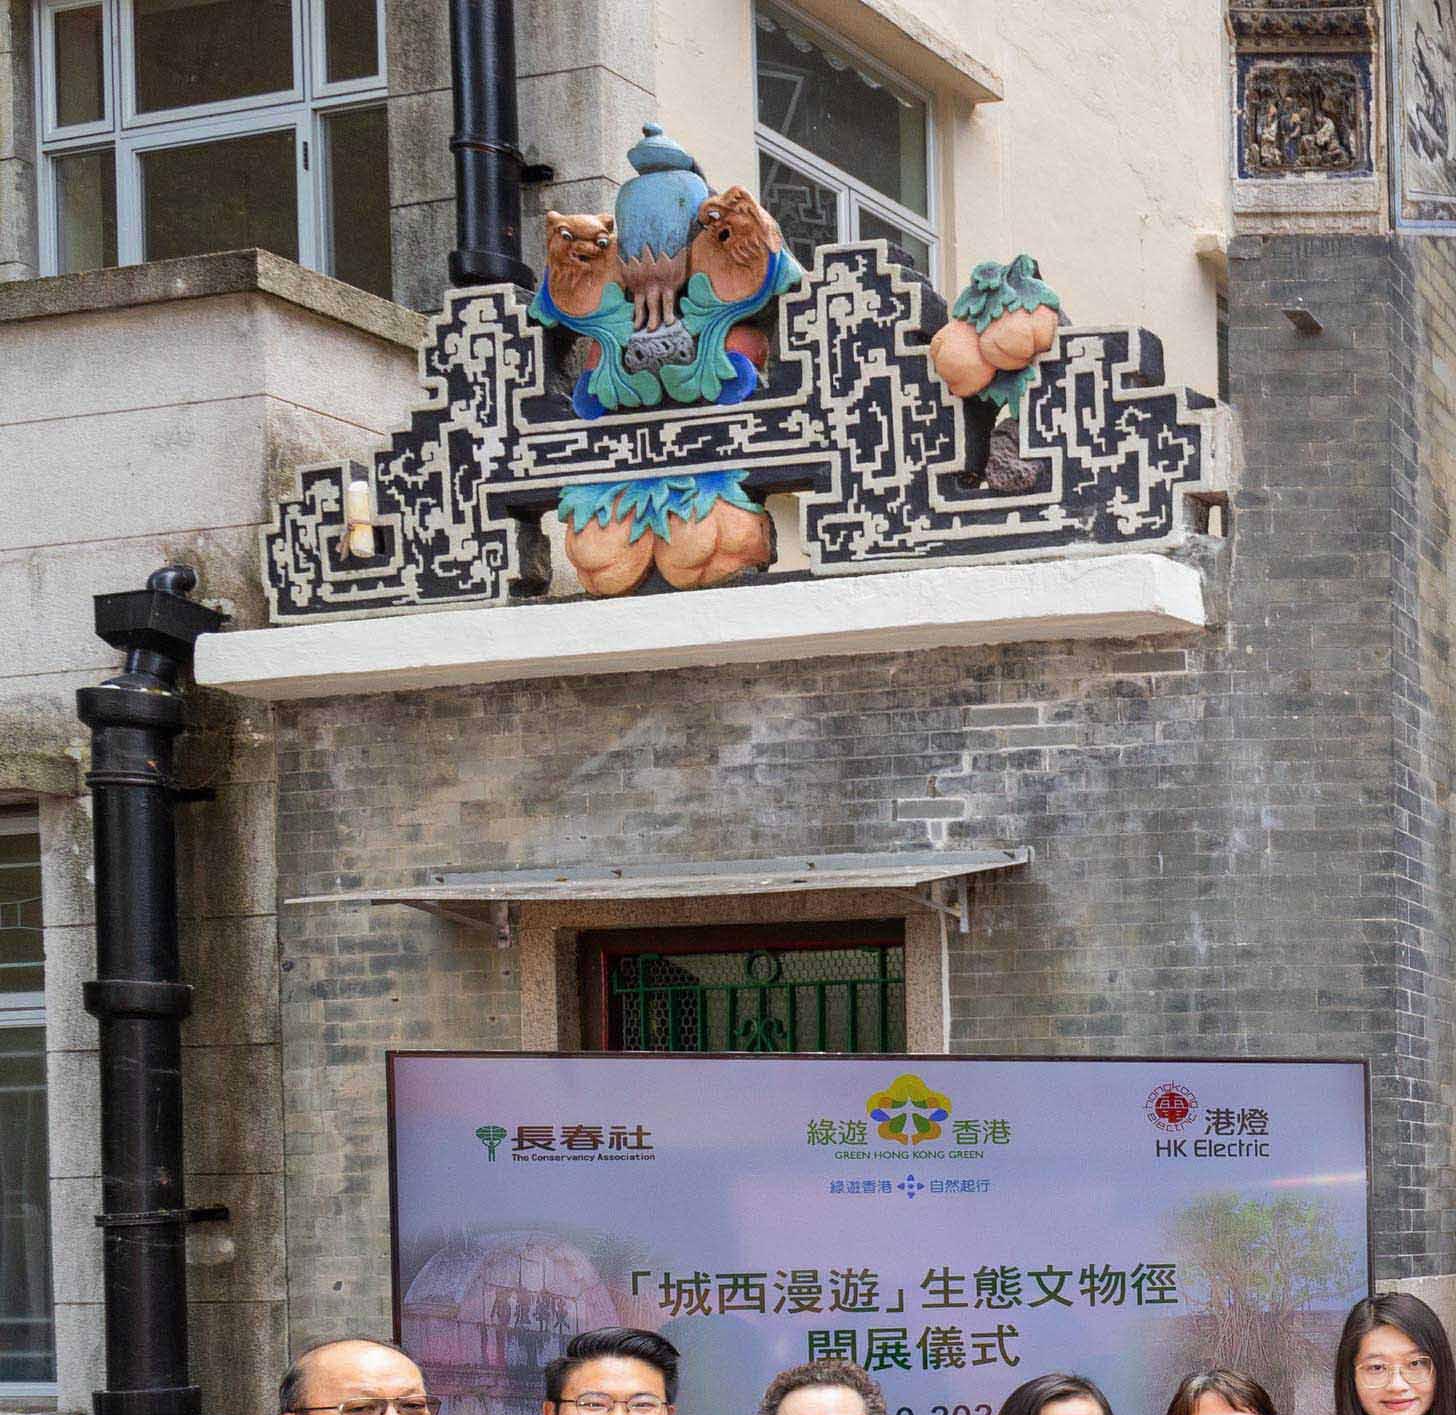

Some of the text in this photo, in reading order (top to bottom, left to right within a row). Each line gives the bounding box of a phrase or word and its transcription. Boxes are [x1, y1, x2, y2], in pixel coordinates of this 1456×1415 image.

[807, 1119, 1012, 1146] 綠遊 香港
[1204, 1108, 1269, 1136] 港燈
[511, 1124, 654, 1152] 長春社
[1155, 1139, 1270, 1158] HK Electric
[531, 1153, 595, 1163] Conservancy
[597, 1152, 656, 1162] Association
[834, 1150, 985, 1160] GREEN HONG KONG GREEN
[808, 1324, 1022, 1372] 開展儀式
